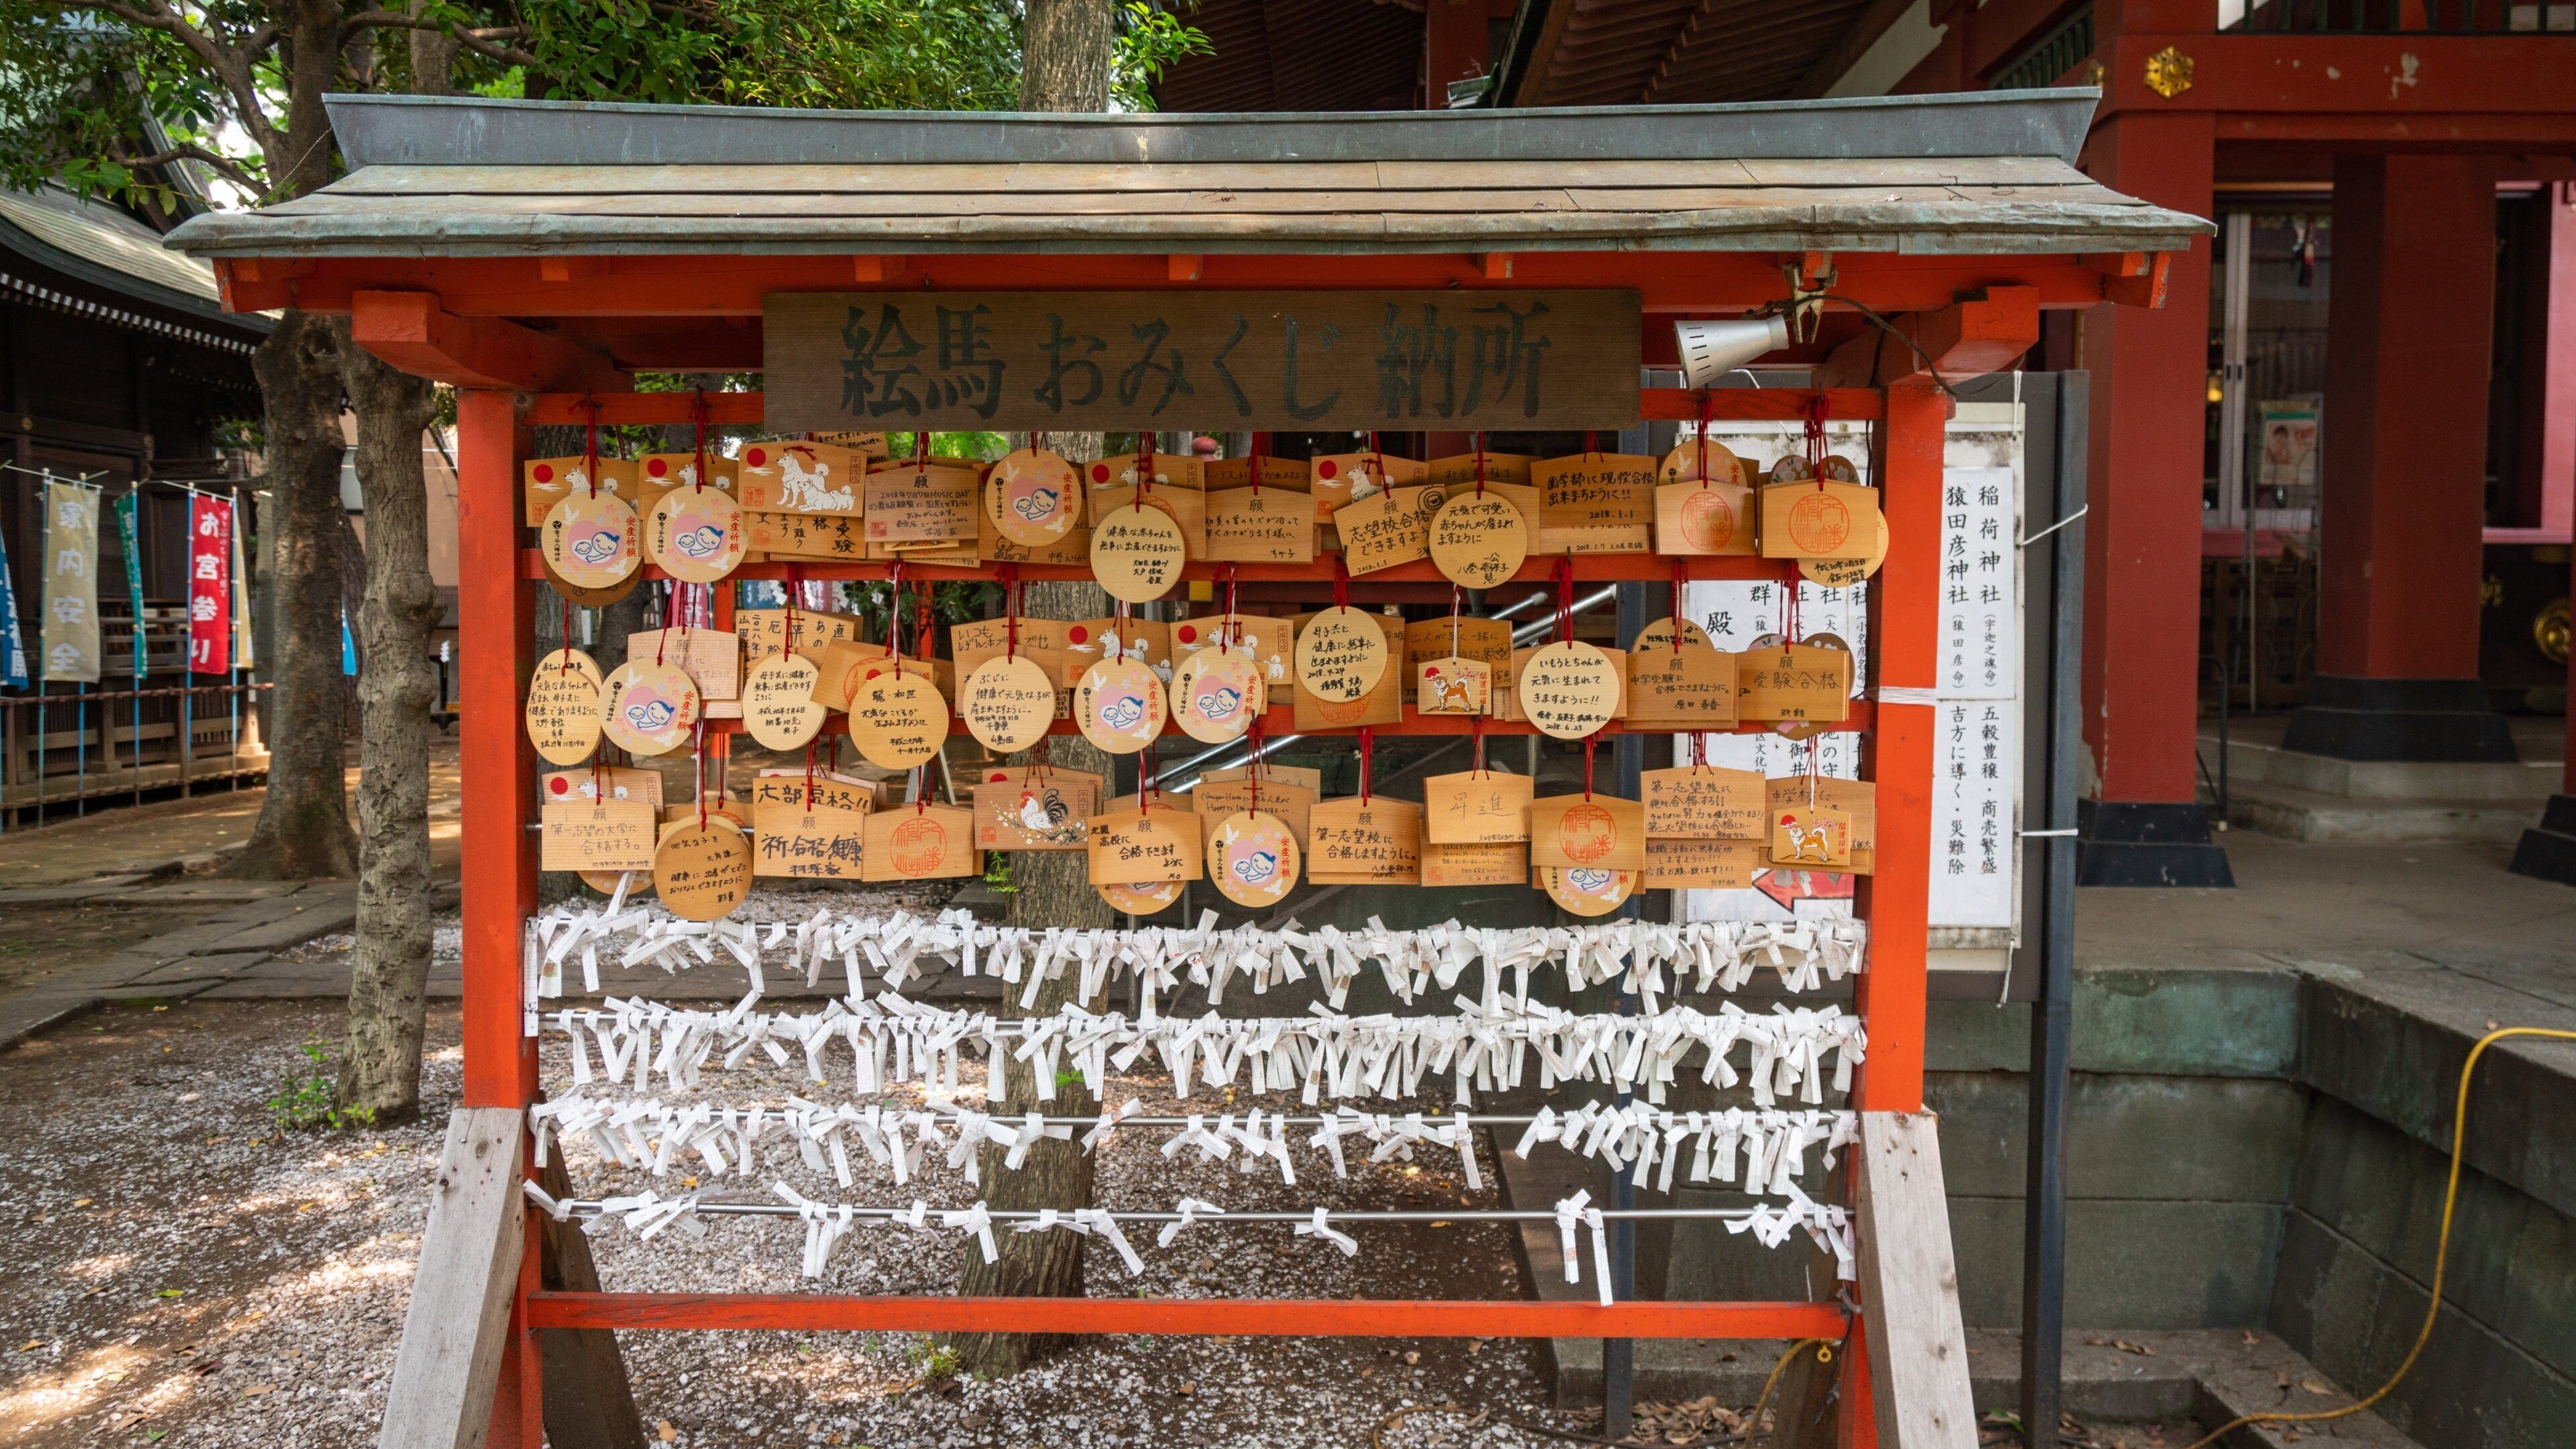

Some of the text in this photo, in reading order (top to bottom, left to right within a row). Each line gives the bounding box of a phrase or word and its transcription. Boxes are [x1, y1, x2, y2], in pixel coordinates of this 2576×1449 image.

[841, 301, 1552, 419] 絵馬おみくじ納所
[914, 475, 928, 488] 願
[1547, 472, 1655, 490] 歯学部に現役合格
[1063, 472, 1073, 514] 安産祈願
[1248, 499, 1264, 513] 願
[1384, 500, 1399, 515] 願
[625, 515, 637, 557] 安産祈願
[729, 511, 740, 553] 安産祈願
[1350, 510, 1430, 544] 志望校合格
[1978, 485, 2001, 604] 稲荷神社
[50, 500, 85, 672] 家内安全
[191, 511, 220, 664] お宮参り
[1945, 485, 1970, 689] 猿田彦神社 （猿田彦命）
[1706, 611, 1734, 635] 殿
[1540, 657, 1604, 668] いもうとちゃんが
[1669, 658, 1684, 671] 願
[1778, 656, 1793, 669] 願
[1531, 675, 1601, 687] 元気に生まれて
[1631, 673, 1684, 684] 中学受験に
[1754, 672, 1842, 692] 受験合格
[1244, 675, 1256, 715] 安産祈願
[1655, 684, 1729, 694] 合格できますように。
[677, 690, 694, 731] 安産祈願
[1148, 680, 1159, 722] 安産祈願
[1651, 780, 1733, 794] 第一志望校に
[1948, 705, 1968, 875] 吉方に導く・災難除
[1980, 706, 2000, 875] 五穀豊穣・商売繁盛
[592, 808, 607, 820] 願
[1450, 792, 1515, 820] 昇進
[802, 816, 816, 829] 願
[1137, 820, 1152, 833] 願
[1357, 812, 1373, 825] 願
[550, 822, 637, 837] 第一志望の大学に
[1316, 826, 1393, 845] 第一志望校に
[1837, 822, 1846, 855] 開運招福
[1119, 843, 1175, 861] 合格できます
[1280, 837, 1291, 878] 安産祈願
[1326, 845, 1416, 861] 合格しますように。
